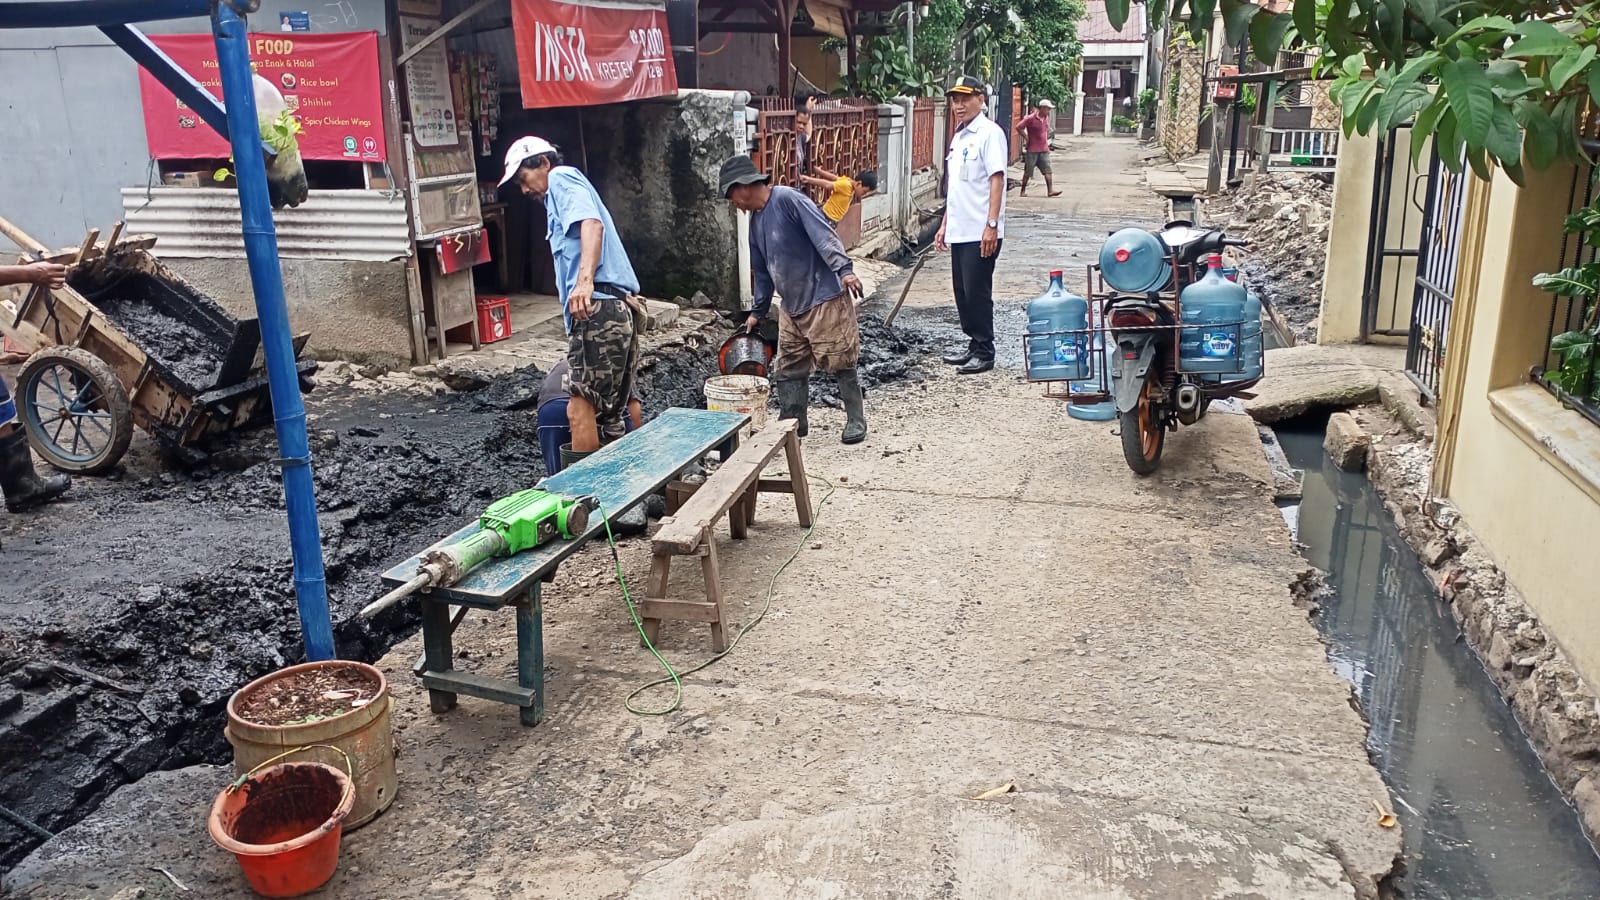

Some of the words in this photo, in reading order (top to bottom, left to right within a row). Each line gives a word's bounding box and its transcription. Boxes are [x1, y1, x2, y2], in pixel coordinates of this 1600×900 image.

[255, 39, 294, 55] FOOD
[535, 20, 595, 82] INSTA
[265, 59, 285, 68] Enak
[286, 60, 293, 68] &
[294, 59, 315, 68] Halal
[300, 77, 317, 87] Rice
[319, 77, 338, 87] bowl
[302, 97, 332, 107] Shihlin
[304, 116, 323, 127] Spicy
[323, 116, 350, 126] Chicken
[350, 116, 371, 128] Wings
